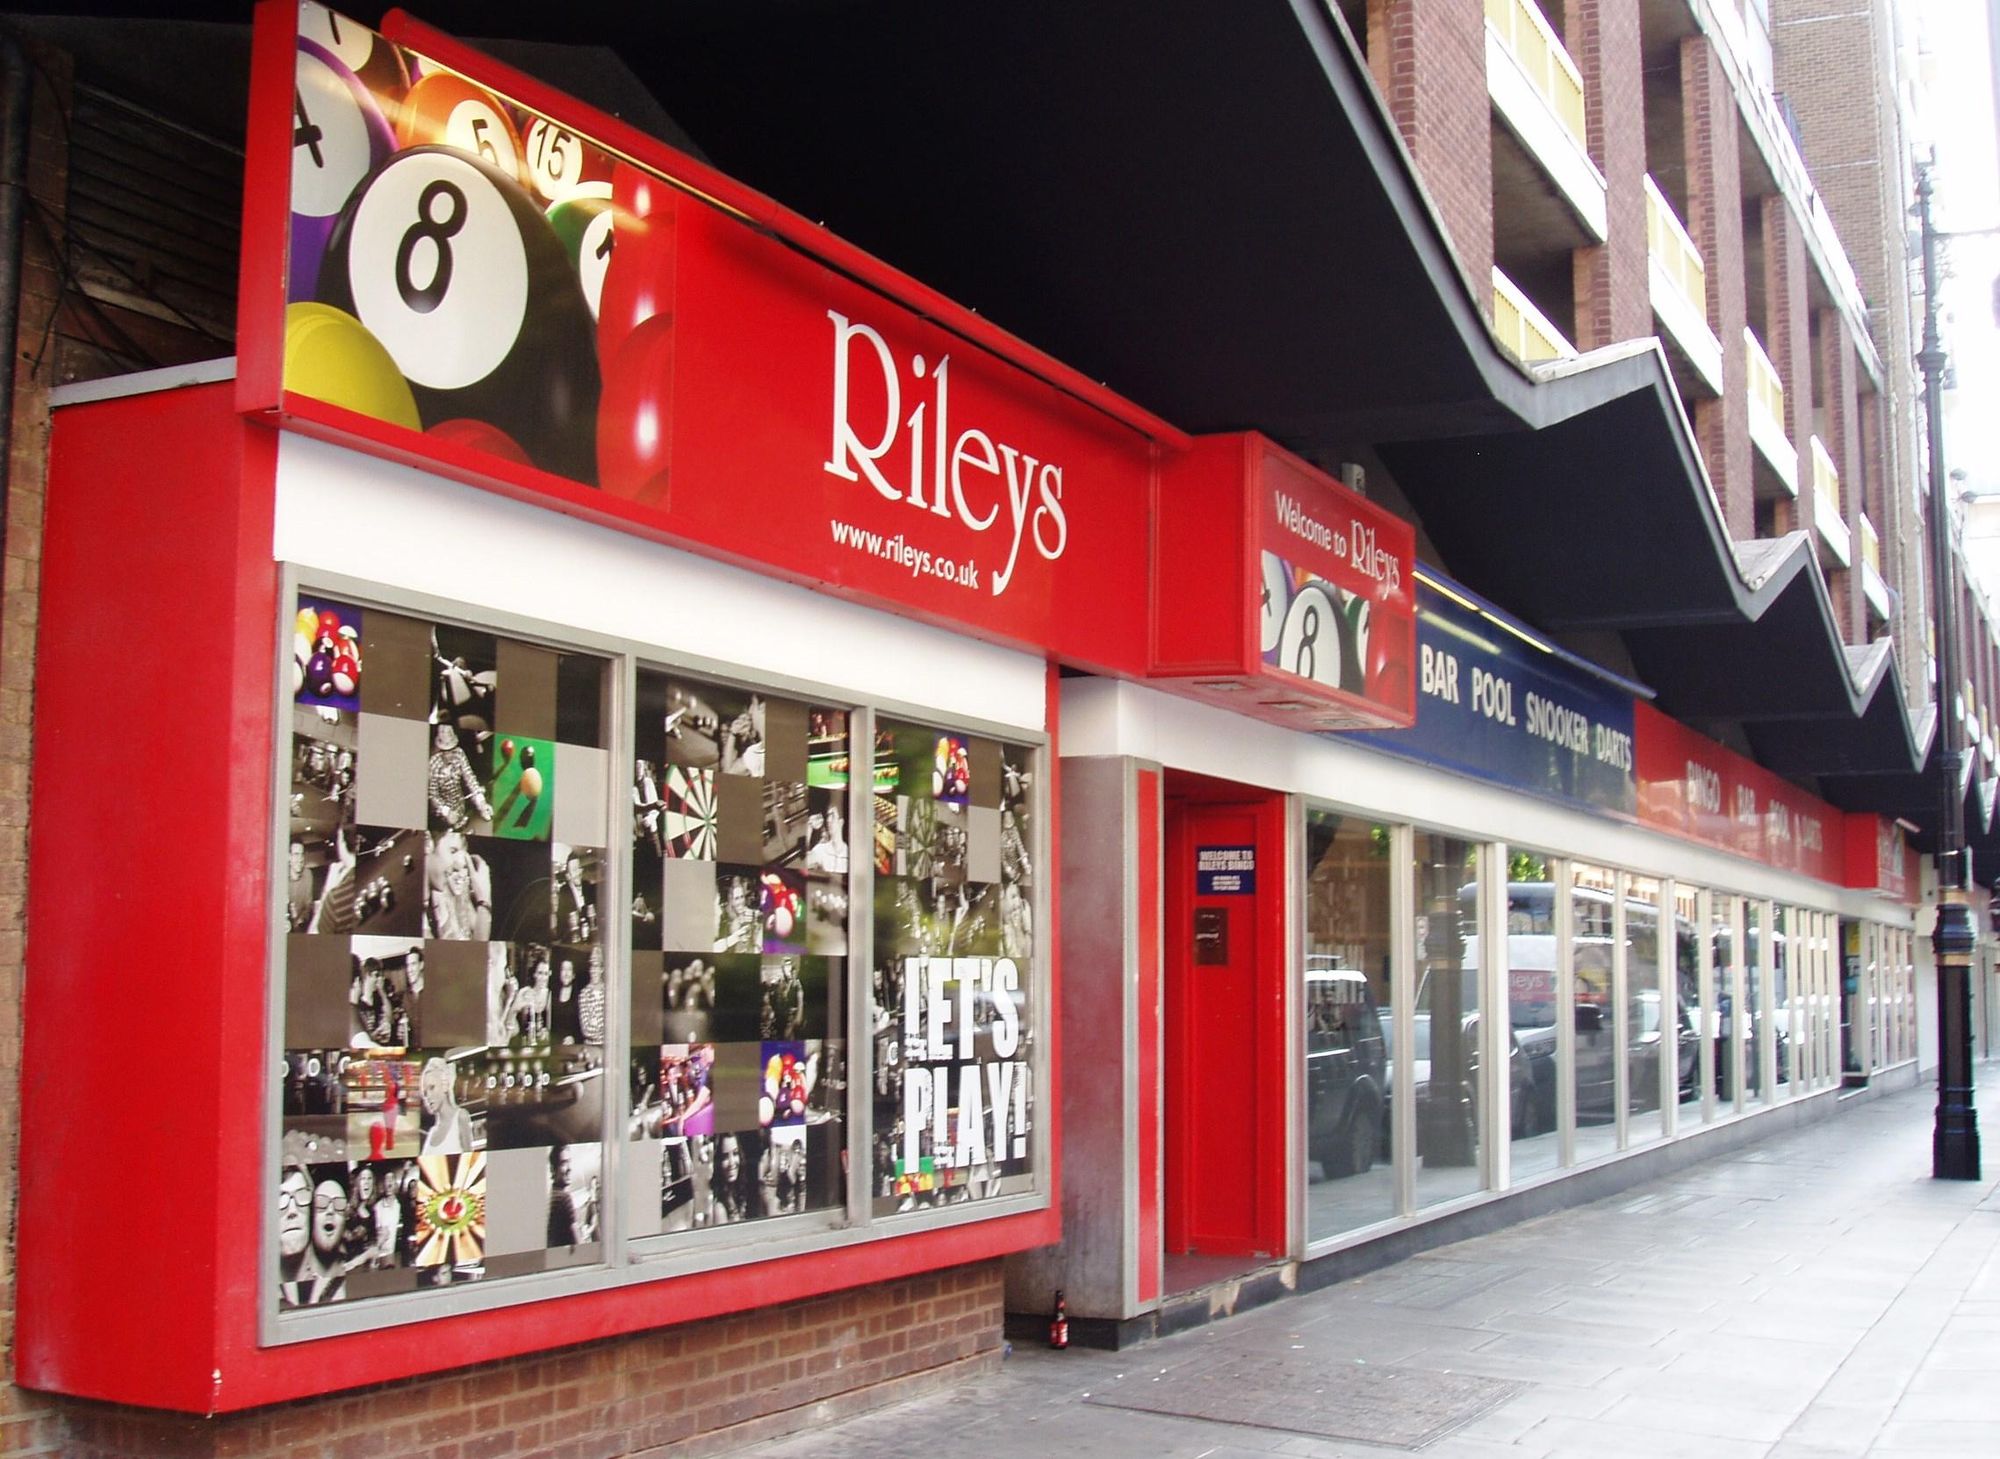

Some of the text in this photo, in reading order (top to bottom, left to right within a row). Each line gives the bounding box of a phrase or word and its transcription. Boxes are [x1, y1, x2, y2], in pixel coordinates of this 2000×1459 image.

[537, 122, 571, 181] 15
[395, 179, 468, 314] 8
[824, 309, 1068, 596] Rileys
[831, 519, 979, 590] www.rileys.co.uk
[1275, 489, 1400, 601] Welcome to Rileys
[1296, 604, 1319, 679] 8
[1420, 643, 1632, 773] BAR POOL SNOOKER DARTS
[905, 957, 1019, 1061] LET'S
[905, 1061, 1027, 1175] PLAY!
